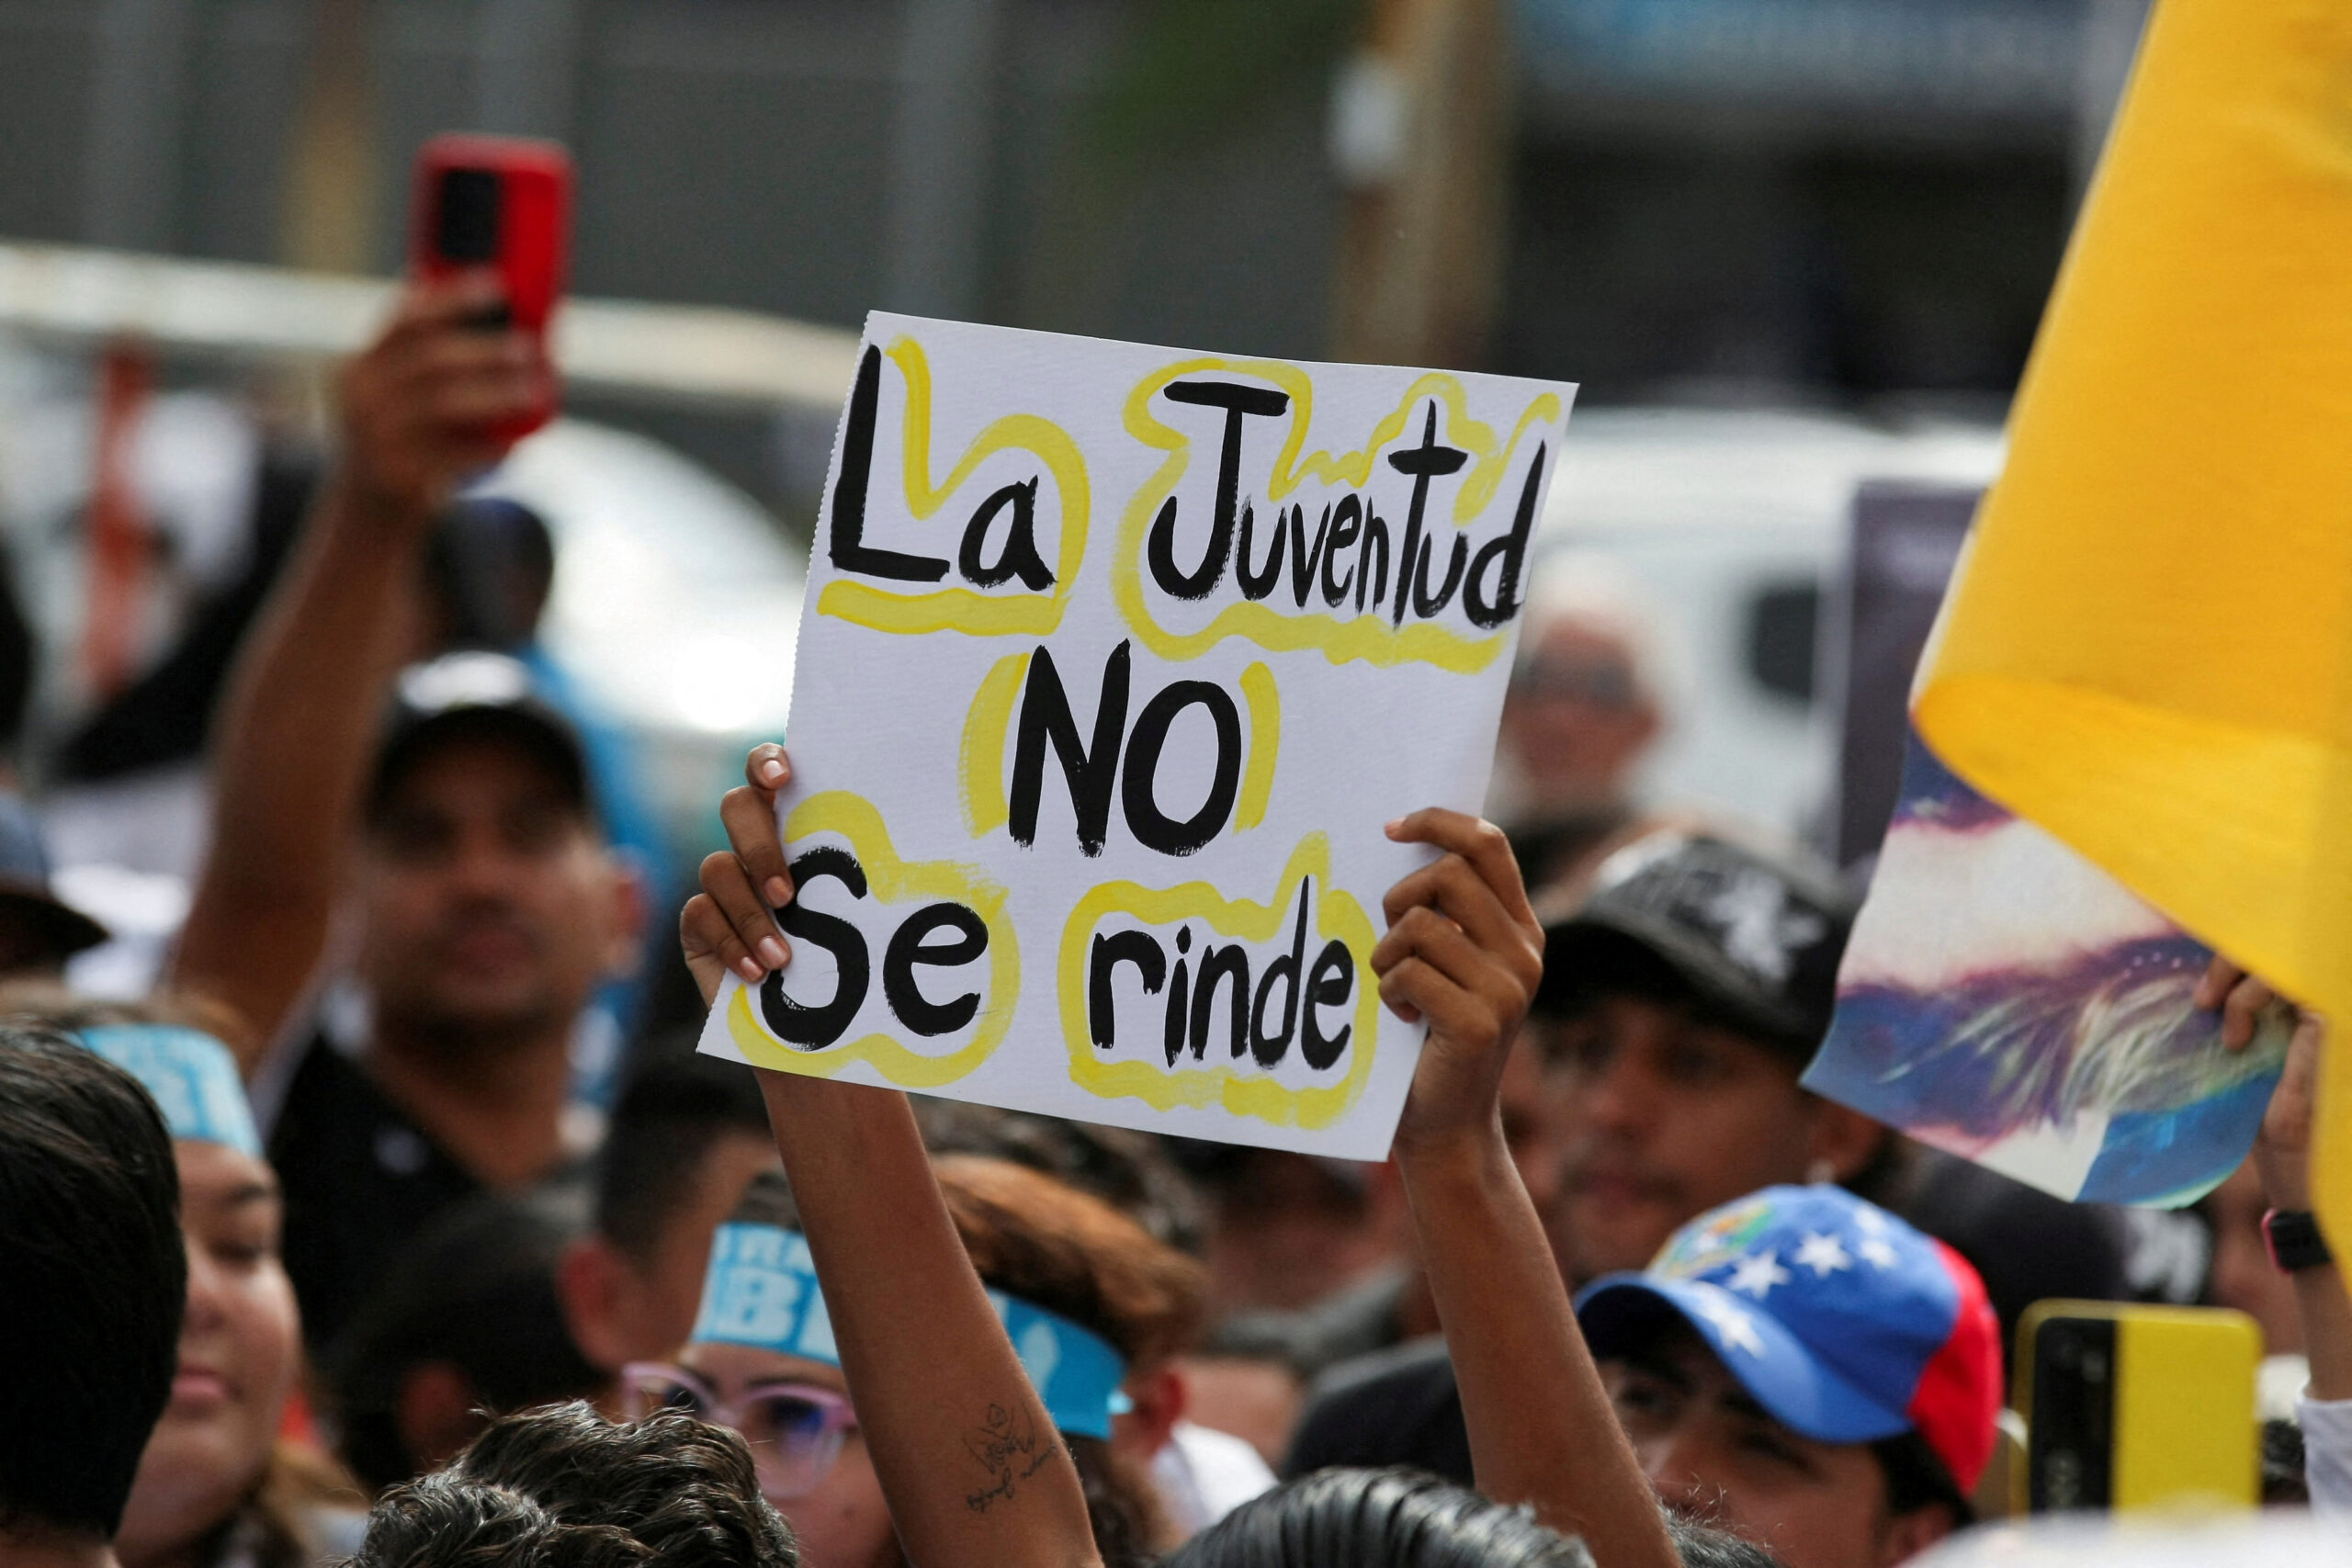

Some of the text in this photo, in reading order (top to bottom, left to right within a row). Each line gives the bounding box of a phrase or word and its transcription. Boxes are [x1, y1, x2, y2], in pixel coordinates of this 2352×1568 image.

[830, 344, 1545, 629] La Juventud
[1009, 638, 1242, 858] NO
[761, 845, 1354, 1070] Se rinde
